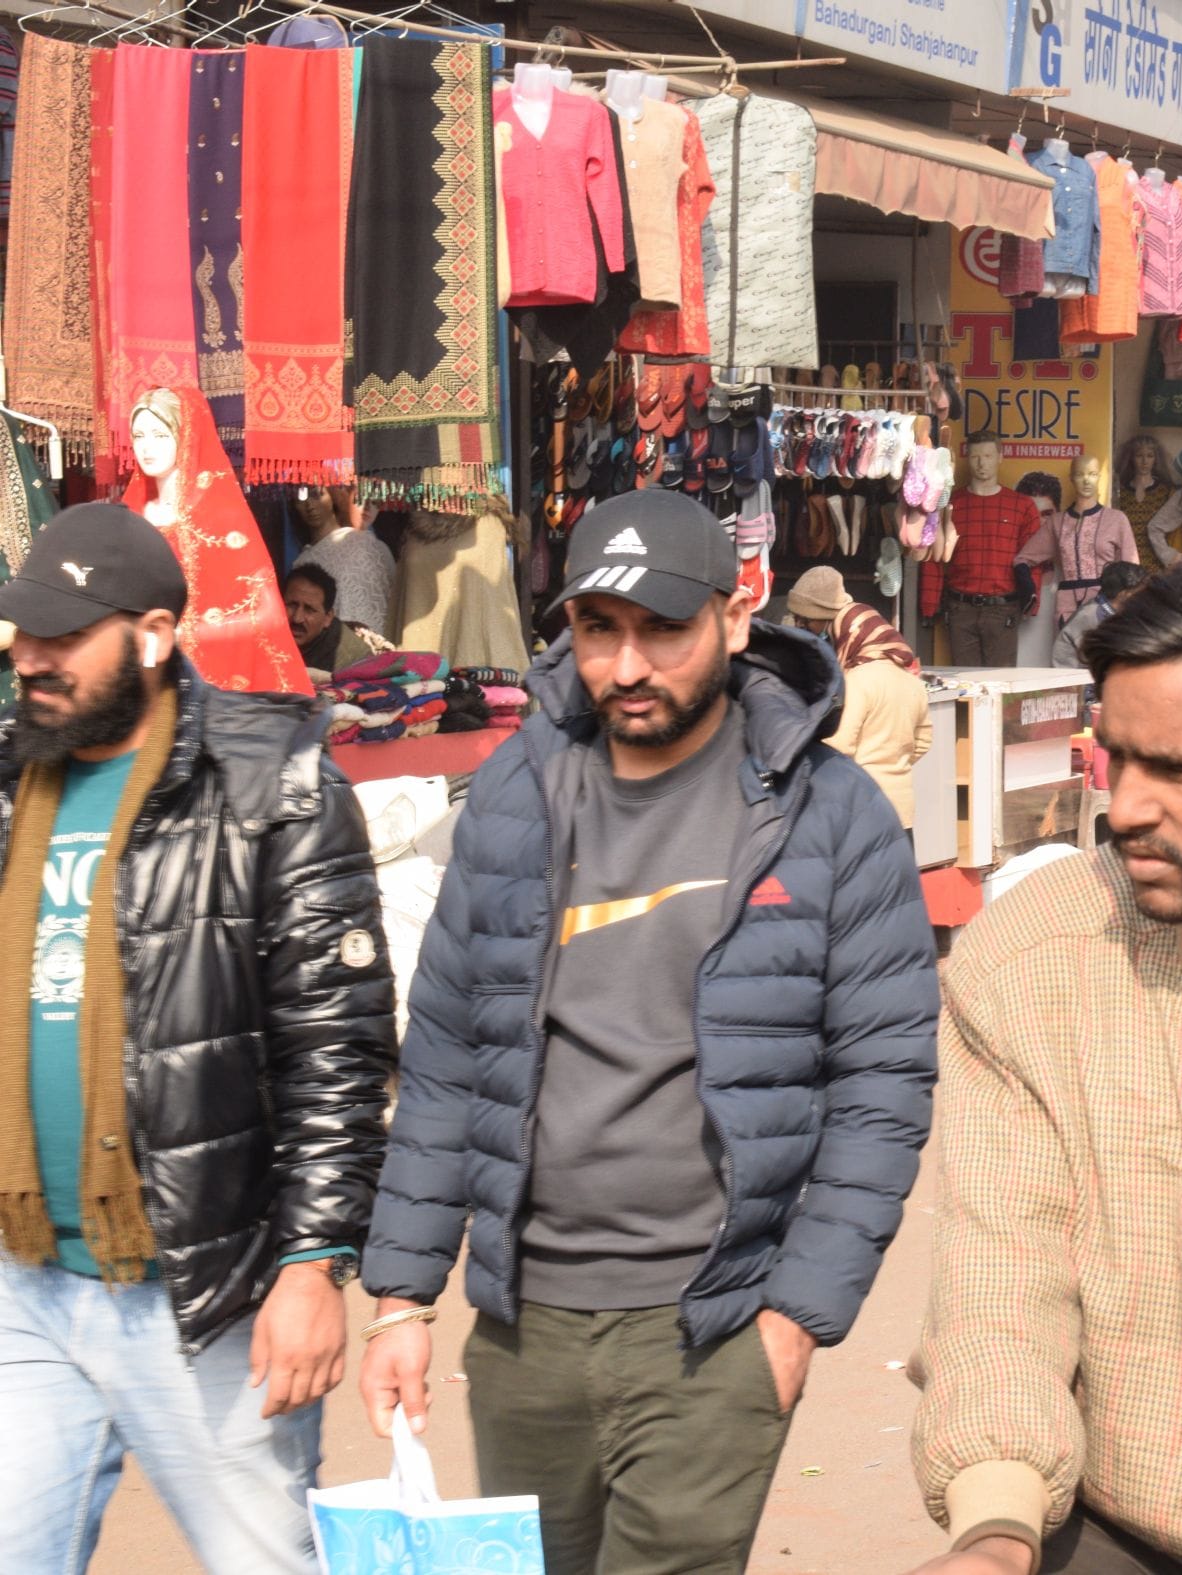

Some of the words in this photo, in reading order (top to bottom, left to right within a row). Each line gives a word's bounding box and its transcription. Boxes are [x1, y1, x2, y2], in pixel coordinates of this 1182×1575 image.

[815, 0, 898, 47] Bahadurganj
[900, 23, 979, 67] Shahjahanpur
[728, 396, 756, 411] uper
[964, 388, 1081, 440] DESIRE
[1016, 444, 1082, 457] INNERWEAR
